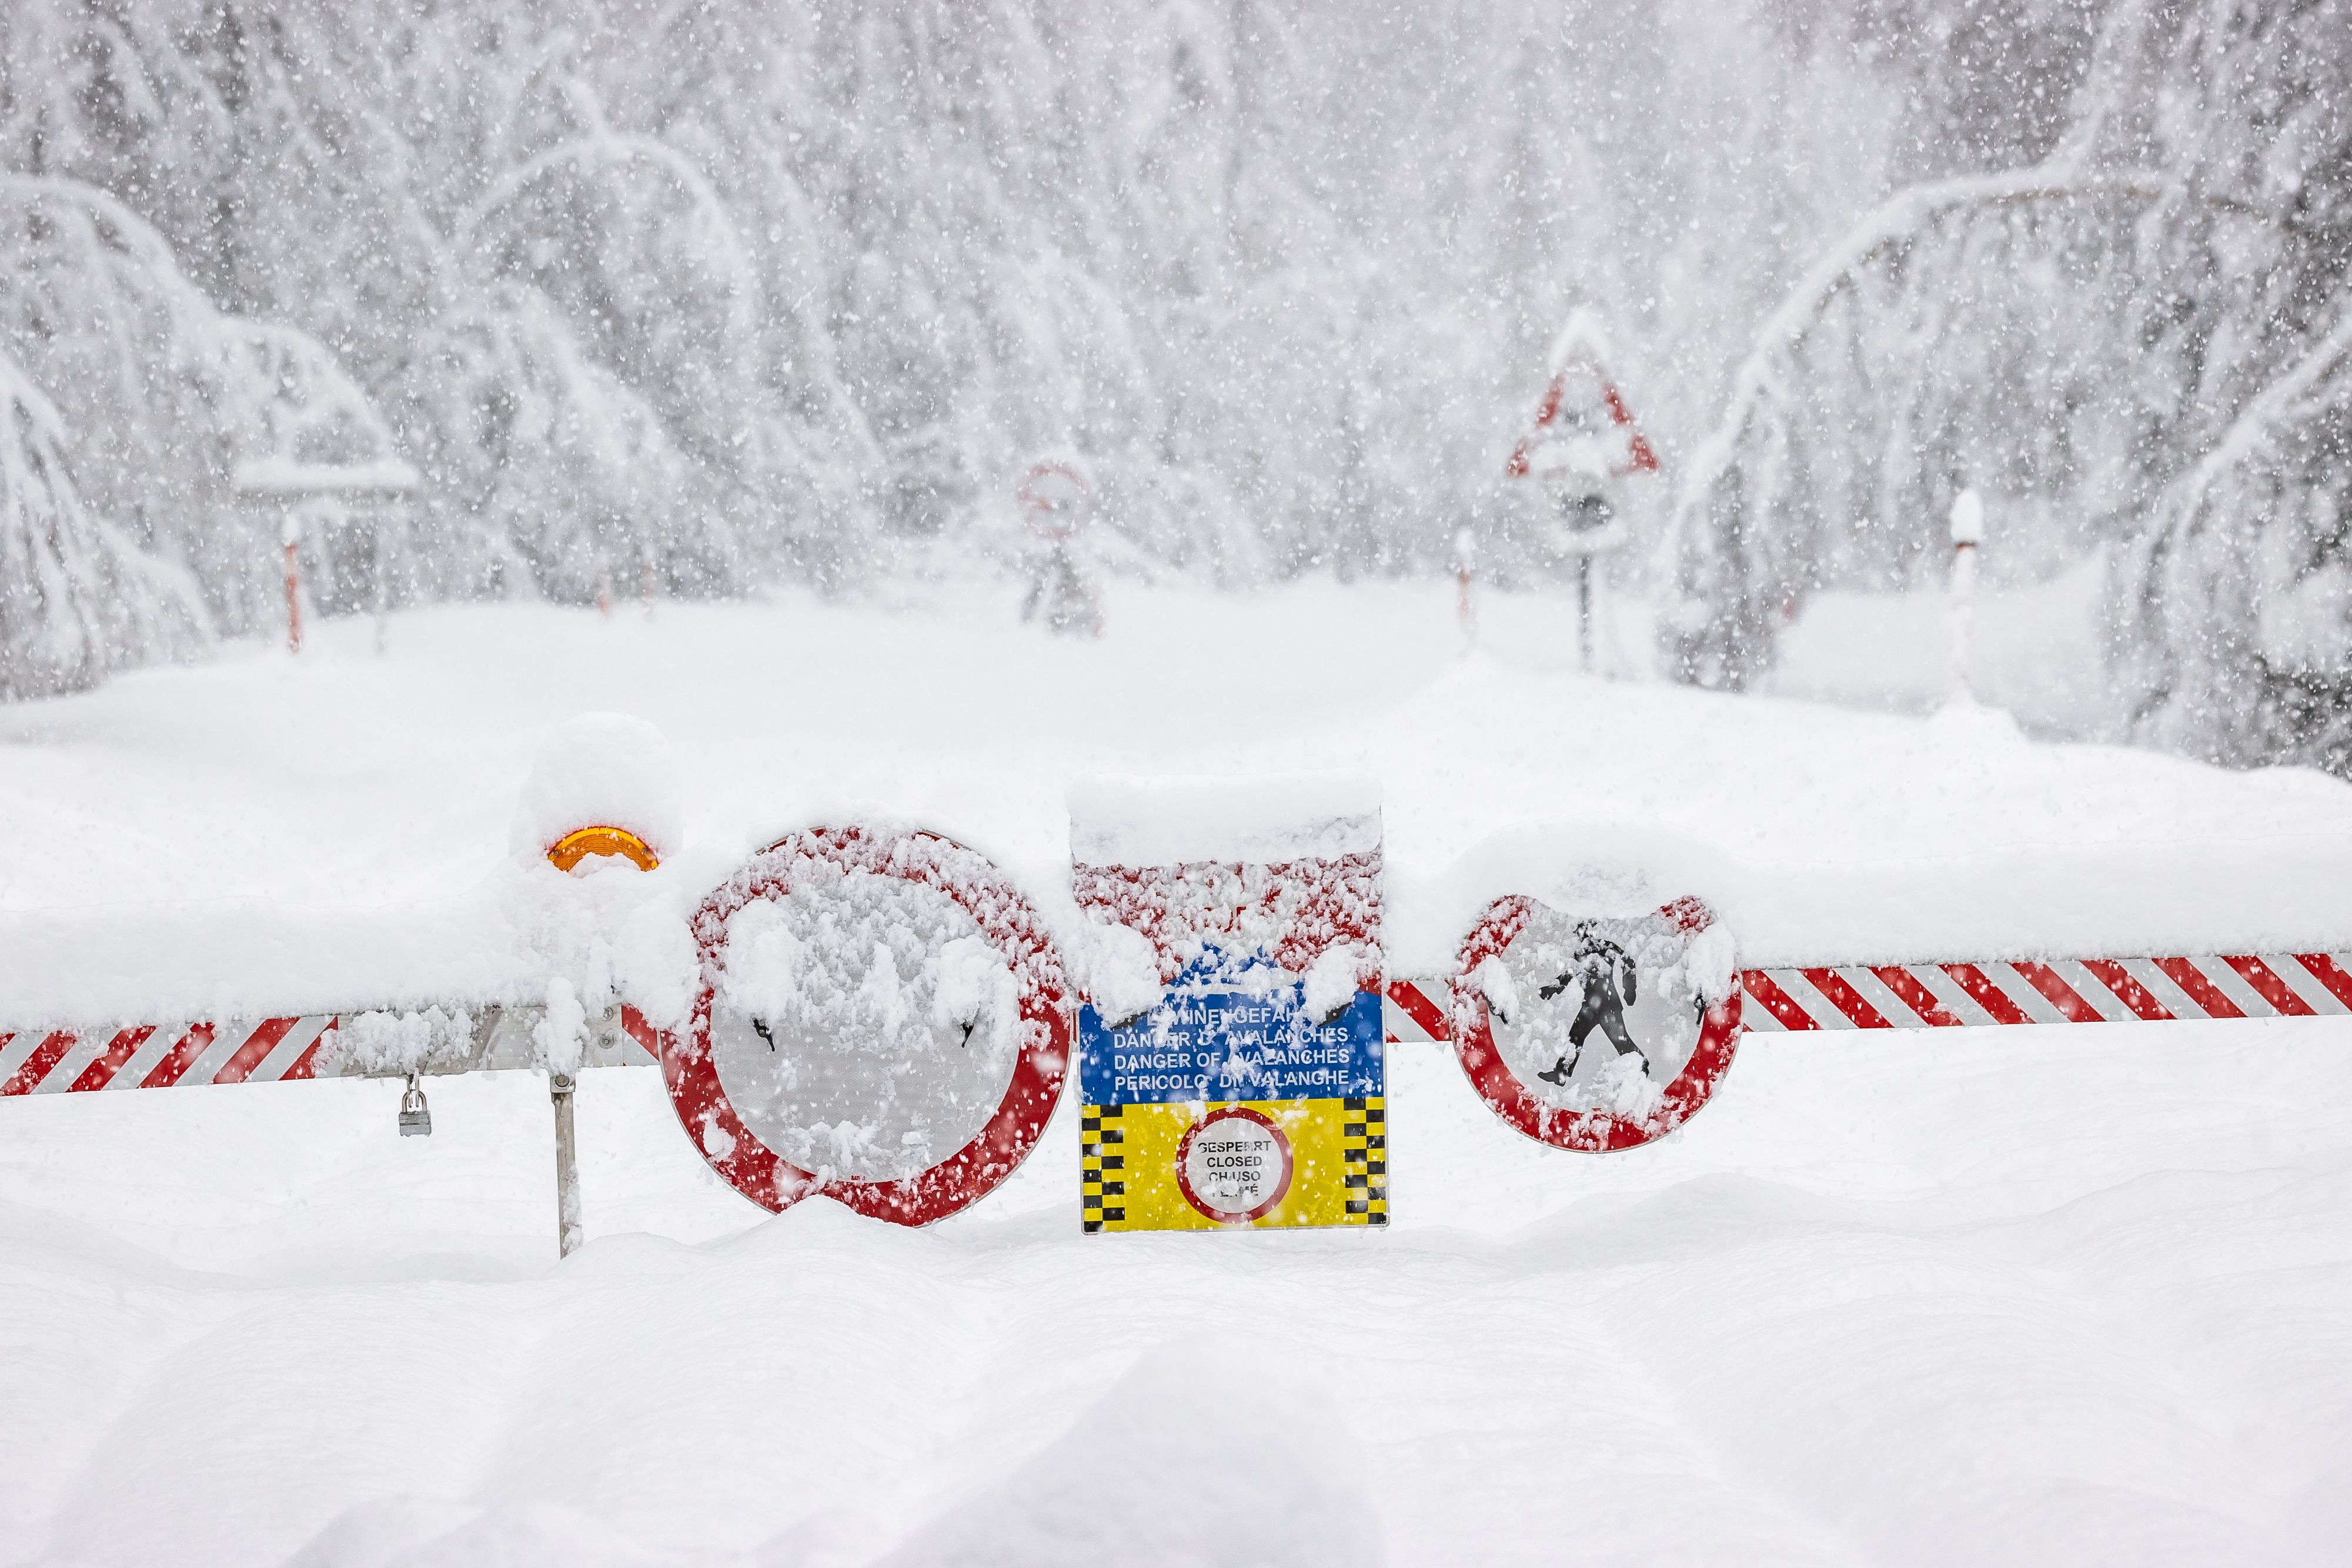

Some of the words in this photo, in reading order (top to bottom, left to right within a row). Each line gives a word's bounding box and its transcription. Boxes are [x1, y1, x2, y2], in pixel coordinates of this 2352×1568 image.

[1114, 1032, 1191, 1049] DANER
[1114, 1053, 1191, 1069] DANGER
[1197, 1052, 1221, 1067] OF
[1115, 1074, 1207, 1091] PERICOLO
[1248, 1070, 1349, 1087] VALANGHE
[1207, 1156, 1262, 1168] CLOSED
[1209, 1171, 1261, 1182] CHUSO
